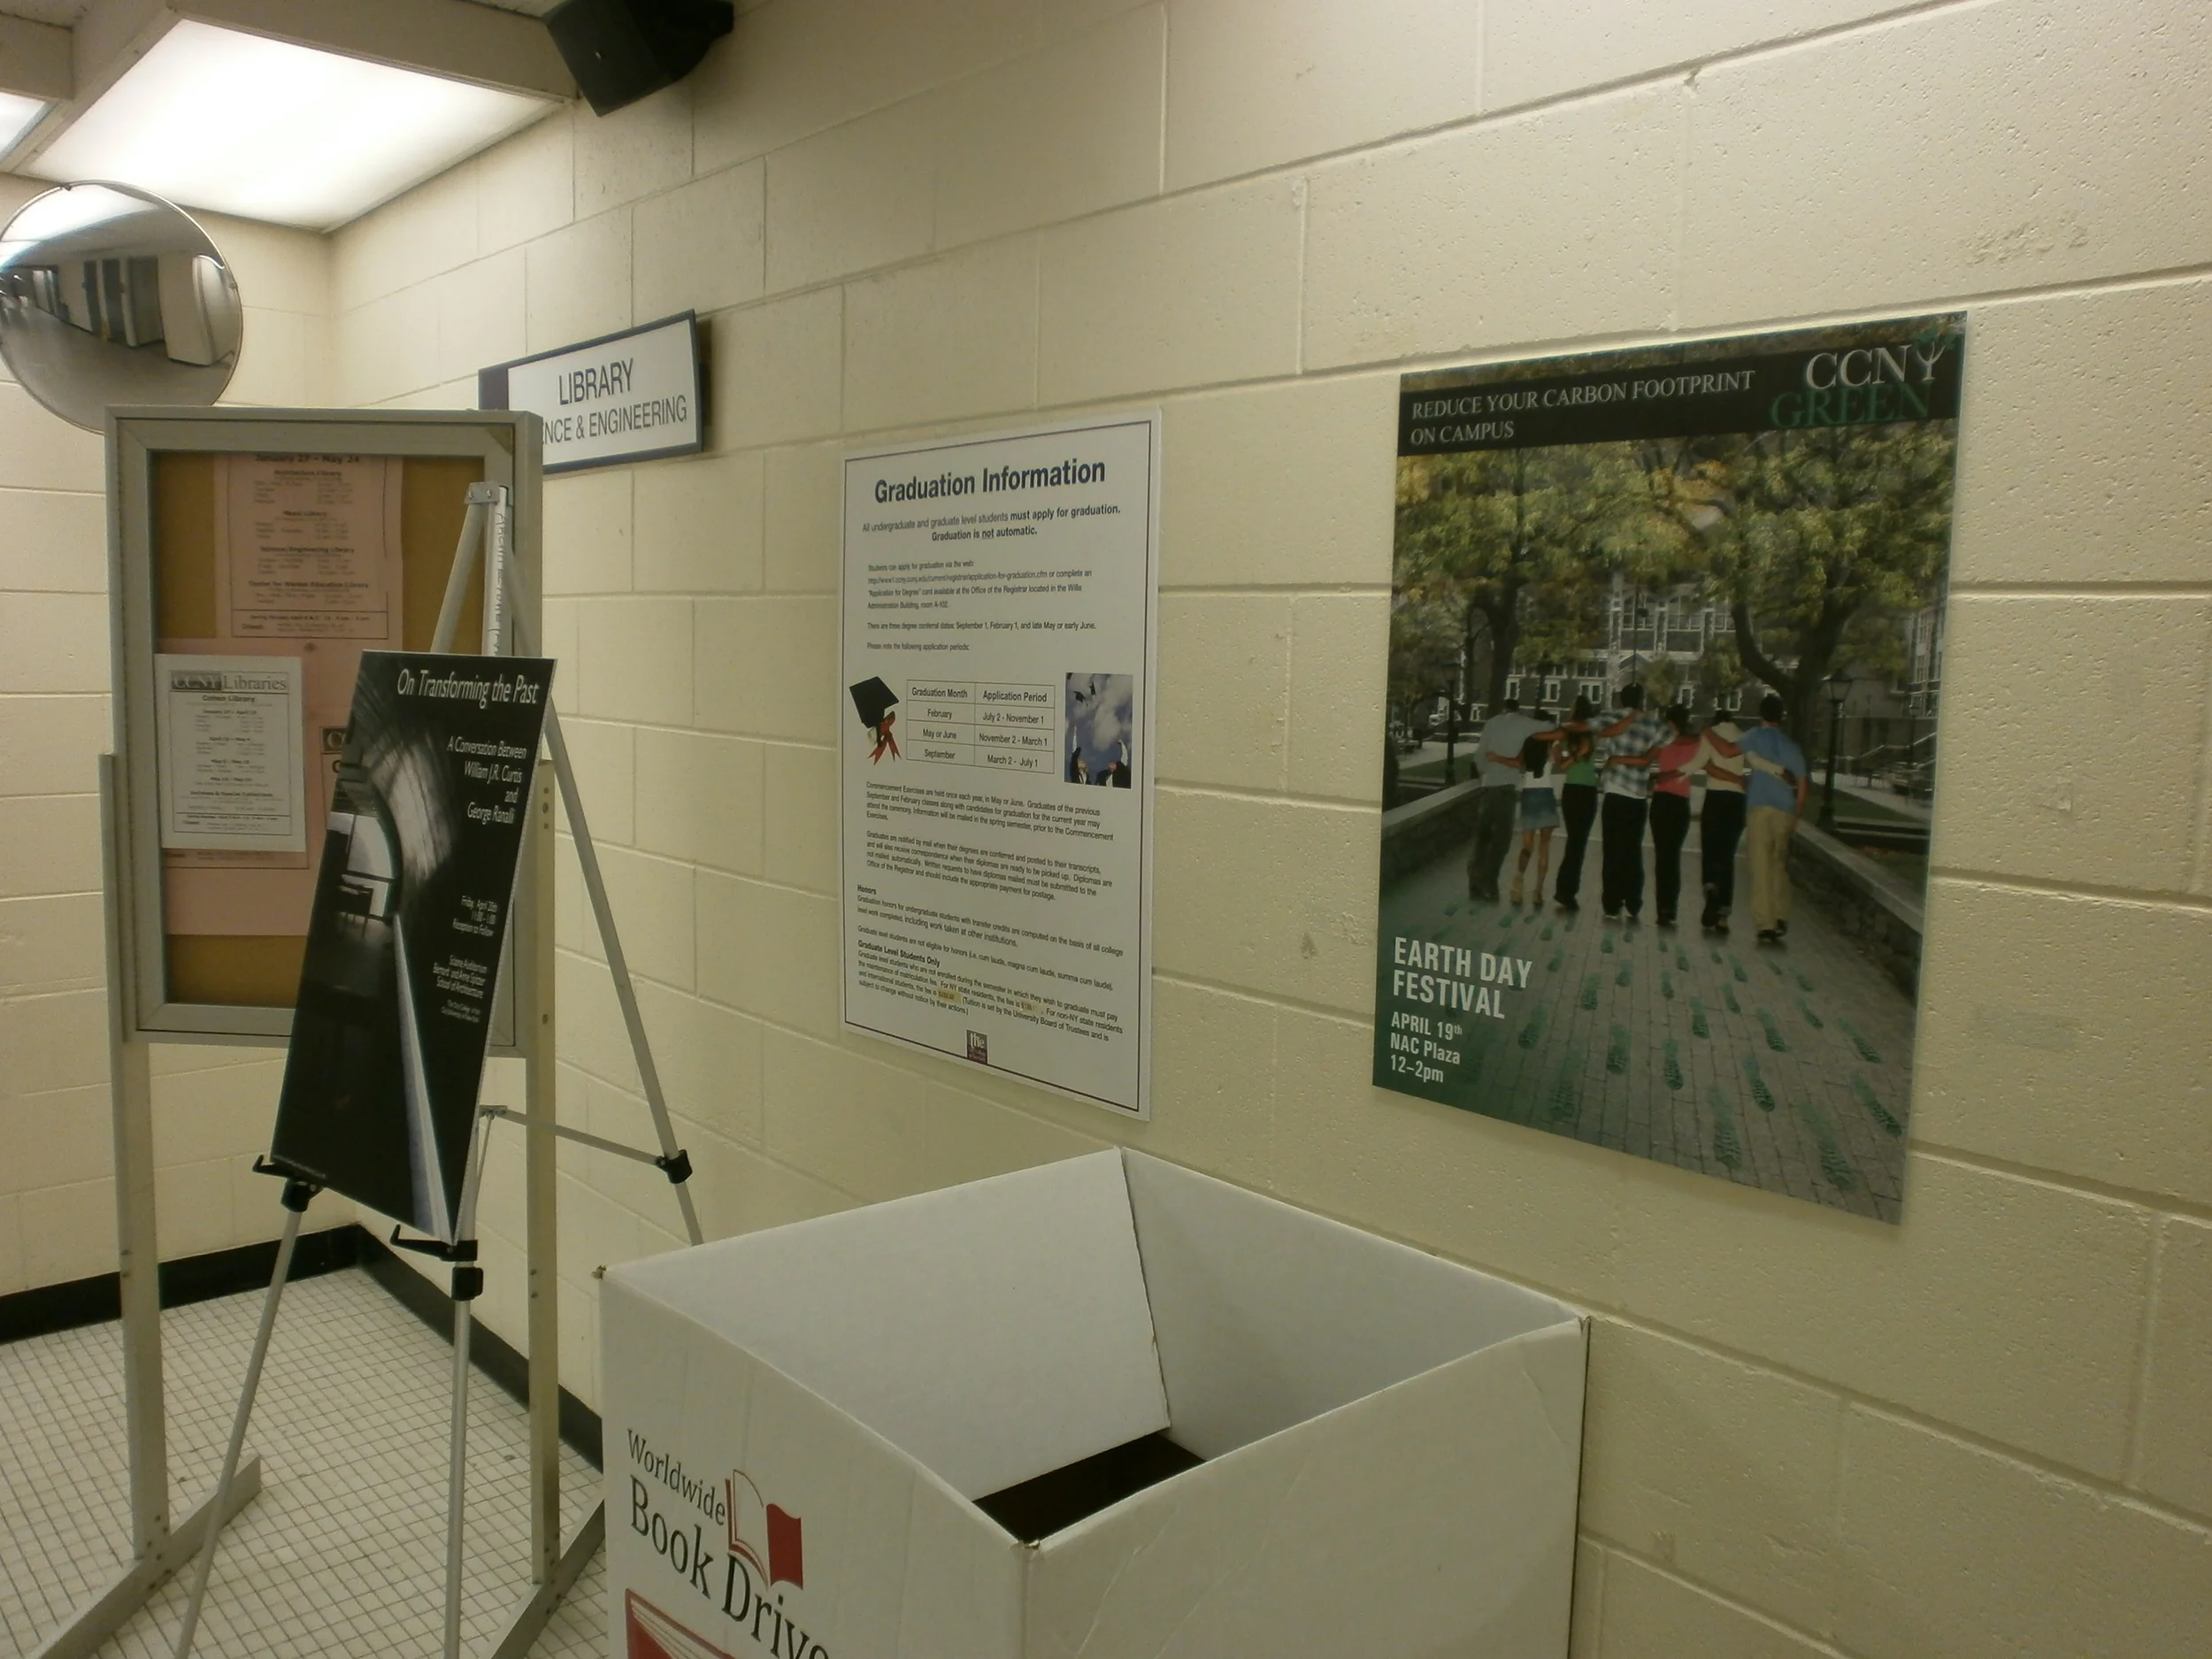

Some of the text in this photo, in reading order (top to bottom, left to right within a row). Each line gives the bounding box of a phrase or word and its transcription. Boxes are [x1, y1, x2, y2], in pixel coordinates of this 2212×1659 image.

[1805, 341, 1946, 390] CCNY
[558, 357, 634, 405] LIBRARY
[1412, 370, 1756, 419] REDUCE YOUR CARBON FOOTPRINT
[1770, 380, 1932, 429] GREEN
[542, 395, 687, 444] NCE & ENGINEERING
[1410, 420, 1515, 446] ON CAMPUS
[875, 457, 1105, 503] Graduation Information
[871, 518, 915, 534] undergraduate
[917, 518, 929, 529] and
[931, 515, 959, 530] graduate
[961, 513, 977, 526] level
[979, 511, 1008, 525] students
[1010, 510, 1030, 522] must
[1033, 507, 1055, 523] apply
[1056, 506, 1069, 519] for
[1071, 503, 1121, 520] graduation.
[932, 525, 1037, 541] Graduation is not automatic.
[222, 674, 288, 691] Libraries
[397, 668, 539, 710] On Transforming the Past
[911, 687, 967, 699] Graduation Month
[227, 695, 256, 704] Library
[983, 691, 1047, 703] Application Period
[926, 709, 952, 720] February
[982, 712, 995, 723] July
[1006, 714, 1038, 725] November
[922, 729, 934, 739] May
[942, 731, 956, 740] June
[979, 733, 1010, 744] November
[1022, 736, 1041, 746] March
[447, 735, 527, 760] A Conversation Between
[924, 749, 955, 761] September
[464, 760, 488, 779] William
[501, 765, 523, 784] Curtis
[987, 755, 1006, 764] March
[1019, 757, 1033, 769] July
[503, 787, 518, 803] and
[467, 801, 492, 825] George
[857, 884, 876, 896] Honors
[857, 940, 940, 969] Graduate Level Students Only
[1394, 936, 1533, 989] EARTH DAY
[1393, 970, 1505, 1019] FESTIVAL
[1391, 1011, 1463, 1041] APRIL 19th
[969, 1033, 986, 1049] the
[1390, 1032, 1460, 1065] NAC Plaza
[626, 1428, 726, 1526] Worldwide
[629, 1473, 715, 1601] Book
